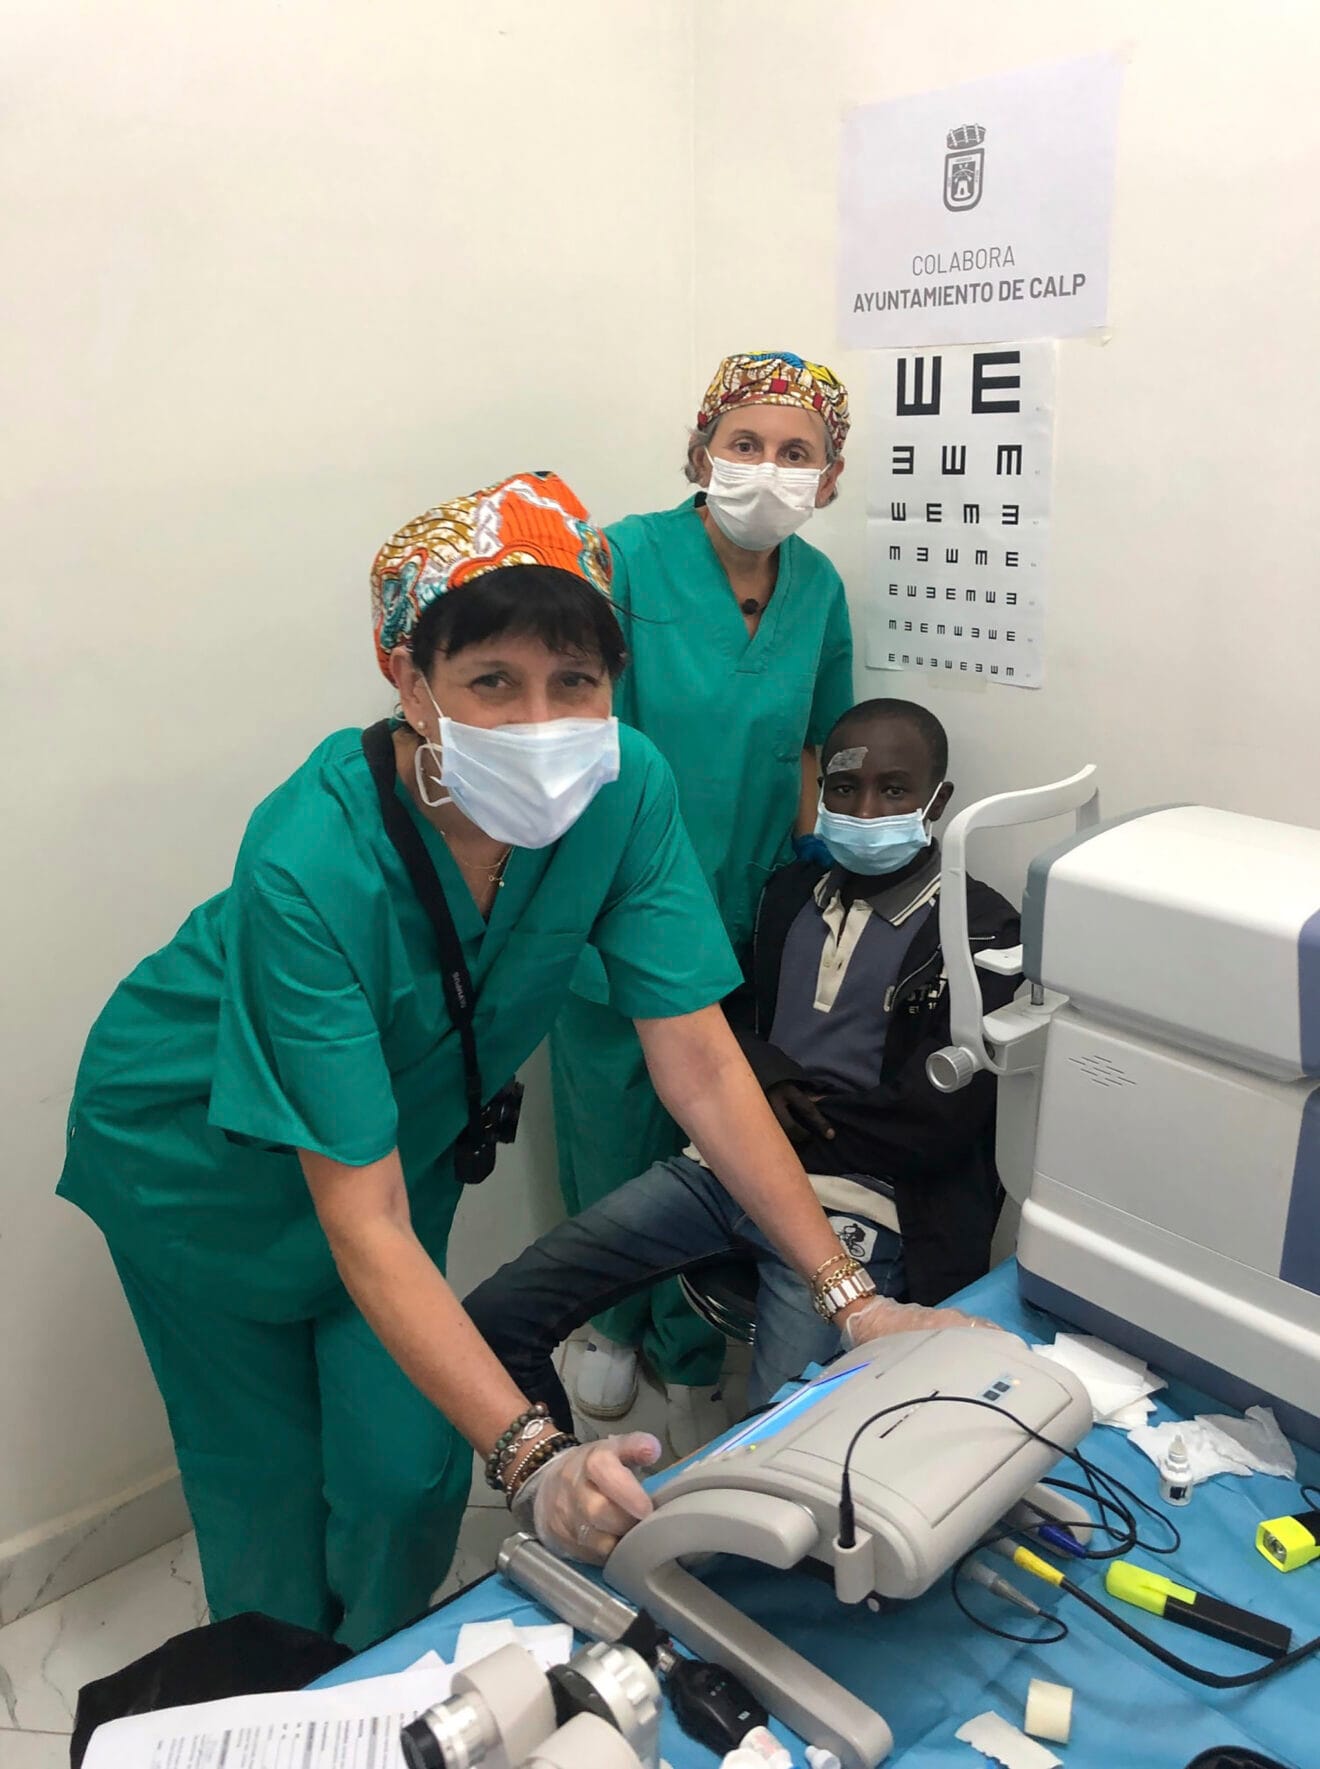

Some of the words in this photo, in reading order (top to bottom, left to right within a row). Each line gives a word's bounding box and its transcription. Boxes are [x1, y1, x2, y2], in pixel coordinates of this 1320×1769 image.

[913, 245, 1015, 277] COLABORA
[853, 282, 993, 313] AYUNTAMIENTO
[998, 279, 1025, 302] DE
[1029, 273, 1086, 299] CALP
